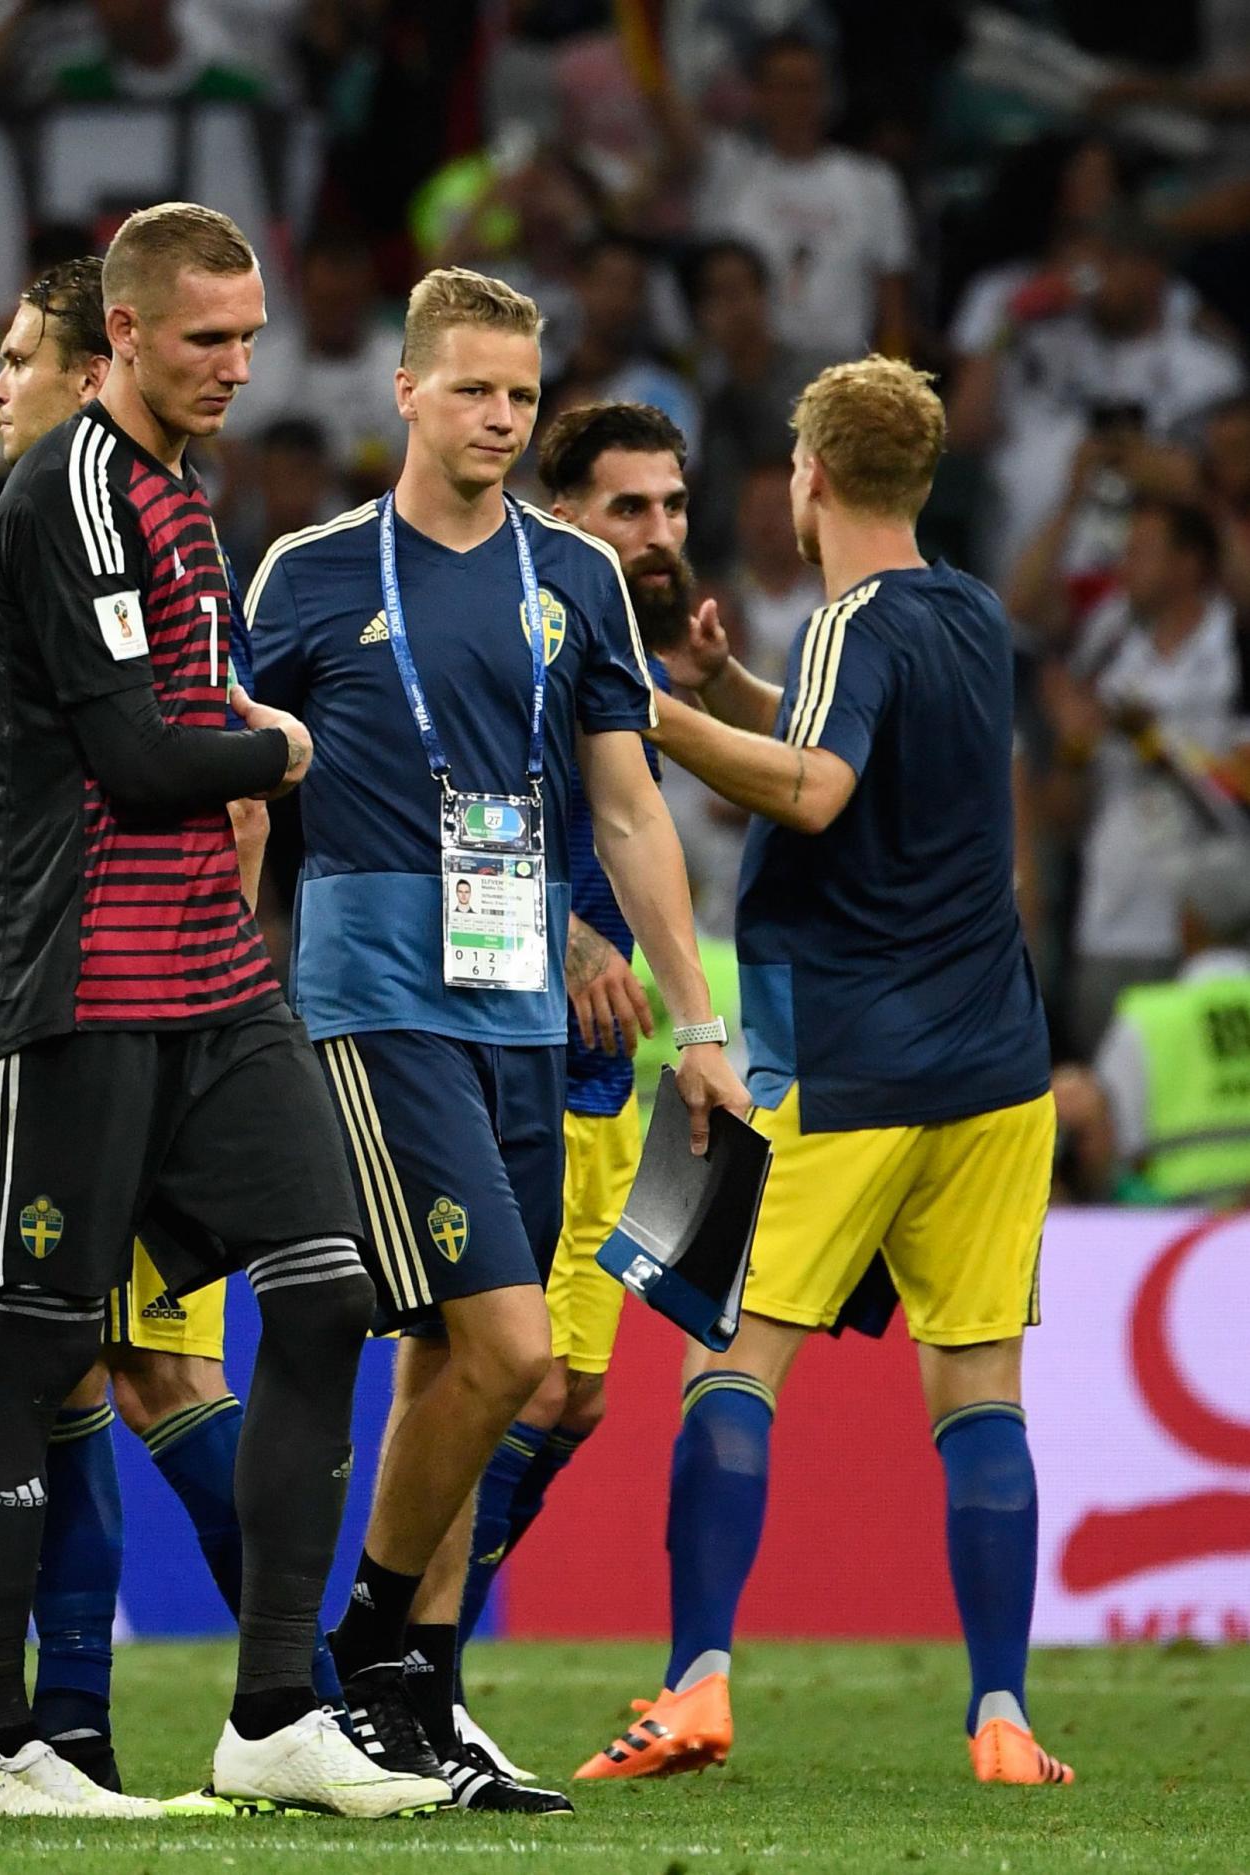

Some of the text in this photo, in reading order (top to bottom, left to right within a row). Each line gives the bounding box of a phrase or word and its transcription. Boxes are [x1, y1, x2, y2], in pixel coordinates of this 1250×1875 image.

[200, 596, 218, 687] 1
[359, 630, 390, 645] adid
[141, 1308, 188, 1321] adidas
